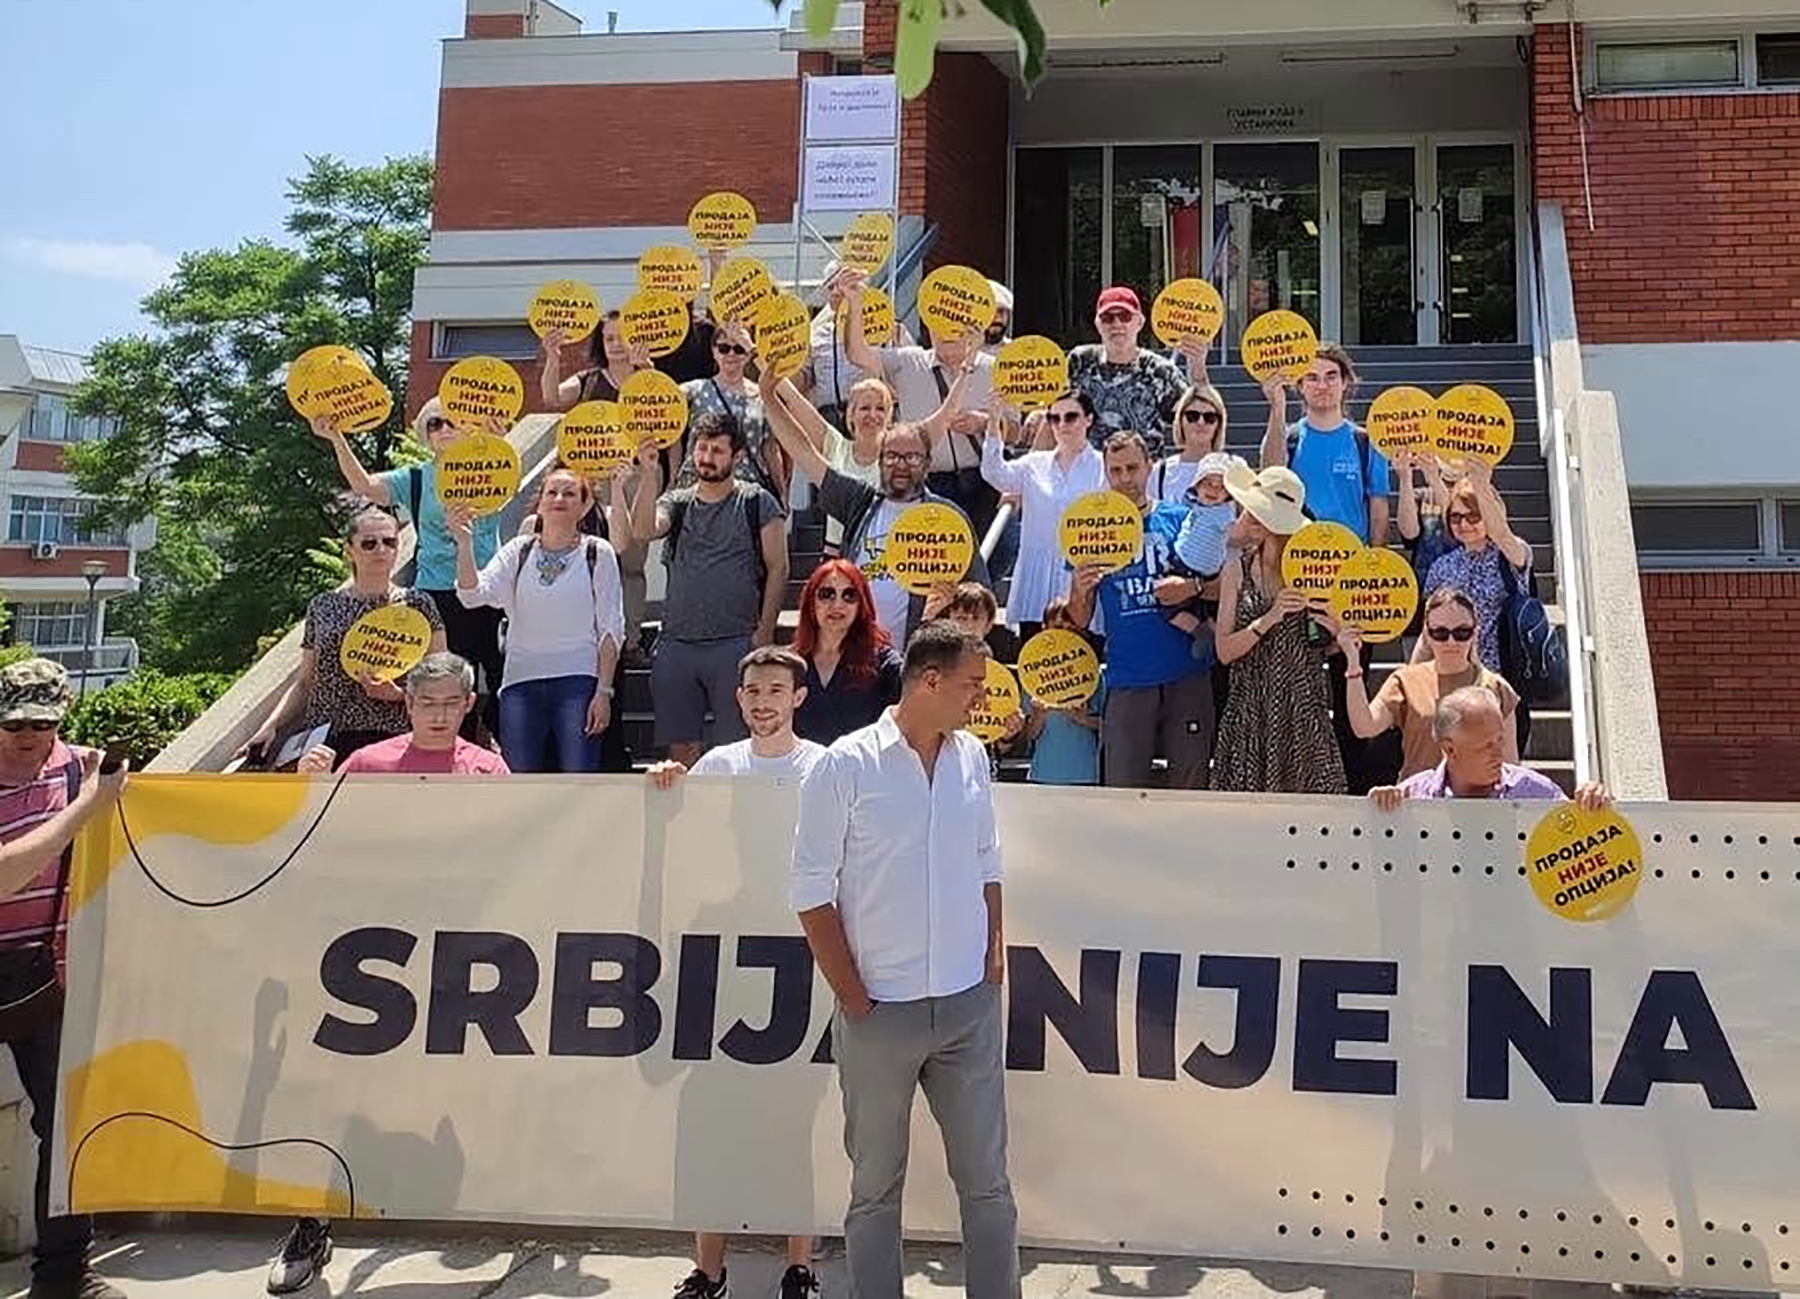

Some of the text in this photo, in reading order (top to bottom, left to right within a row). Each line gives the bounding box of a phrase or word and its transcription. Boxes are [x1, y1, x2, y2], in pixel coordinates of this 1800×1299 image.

[695, 211, 749, 220] ПРОДАЈА
[704, 222, 735, 230] НИЈЕ
[849, 232, 889, 242] ПРОДАЈА
[642, 262, 697, 272] ПРОДАЈА
[653, 274, 683, 283] НИЈЕ
[713, 269, 761, 303] ПРОДАЈА
[725, 287, 753, 307] НИЈЕ
[933, 281, 991, 307] ПРОДАЈА
[536, 298, 594, 310] ПРОДАЈА
[722, 289, 767, 321] ОПЦИЈА!
[940, 296, 973, 313] НИЈЕ
[1161, 297, 1217, 314] ПРОДАЈА
[544, 308, 575, 318] НИЈЕ
[624, 307, 681, 322] ПРОДАЈА
[1168, 309, 1200, 323] НИЈЕ
[535, 319, 589, 329] ОПЦИЈА!
[636, 319, 668, 331] НИЈЕ
[760, 315, 805, 337] ПРОДАЈА
[1157, 320, 1210, 337] ОПЦИЈА!
[629, 328, 683, 345] ОПЦИЈА!
[1247, 331, 1309, 347] ПРОДАЈА
[765, 343, 806, 362] ОПЦИЈА!
[1260, 346, 1294, 359] НИЈЕ
[999, 358, 1060, 370] ПРОДАЈА
[1252, 355, 1309, 371] ОПЦИЈА!
[1009, 372, 1044, 382] НИЈЕ
[314, 378, 374, 402] ПРОДАЈА
[450, 376, 516, 394] ПРОДАЈА
[1001, 382, 1058, 394] ОПЦИЈА!
[332, 392, 368, 409] НИЈЕ
[459, 390, 496, 405] НИЈЕ
[623, 395, 681, 406] ПРОДАЈА
[330, 398, 387, 422] ОПЦИЈА!
[447, 402, 510, 418] ОПЦИЈА!
[633, 408, 667, 419] НИЈЕ
[1373, 409, 1431, 423] ПРОДАЈ
[1437, 409, 1505, 428] ПРОДАЈА
[565, 424, 622, 435] ПРОДАЈ
[626, 421, 681, 432] ОПЦИЈА!
[1385, 423, 1421, 435] НИЈЕ
[1447, 425, 1486, 440] НИЈЕ
[577, 437, 615, 448] НИЈЕ
[1379, 434, 1429, 447] ОПЦИЈ
[1436, 438, 1500, 455] ОПЦИЈА!
[567, 449, 631, 460] ОПЦИЈА!
[444, 459, 512, 472] ПРОДАЈА
[455, 474, 492, 486] НИЈЕ
[444, 486, 507, 499] ОПЦИЈА!
[1066, 516, 1135, 528] ПРОДАЈА
[895, 532, 966, 545] ПРОДАЈА
[1079, 530, 1117, 542] НИЈЕ
[907, 548, 948, 559] НИЈЕ
[1069, 543, 1134, 556] ОПЦИЈА!
[896, 562, 962, 574] ОПЦИЈА!
[1293, 578, 1334, 589] ОПЦИ
[1340, 578, 1410, 590] ПРОДАЈА
[1351, 594, 1389, 606] НИЈЕ
[1342, 609, 1407, 621] ОПЦИЈА!
[358, 624, 422, 647] ПРОДАЈА
[362, 640, 399, 657] НИЈЕ
[347, 650, 408, 669] ОПЦИЈА!
[1023, 647, 1088, 673] ПРОДАЈА
[1039, 665, 1076, 683] НИЈЕ
[1036, 672, 1095, 696] ОПЦИЈА!
[1535, 825, 1623, 873] ПРОДАЈА
[1558, 852, 1608, 884] НИЈЕ
[1555, 859, 1637, 907] ОПЦИЈА!
[312, 926, 1757, 1110] SRBIJ NIJE NA
